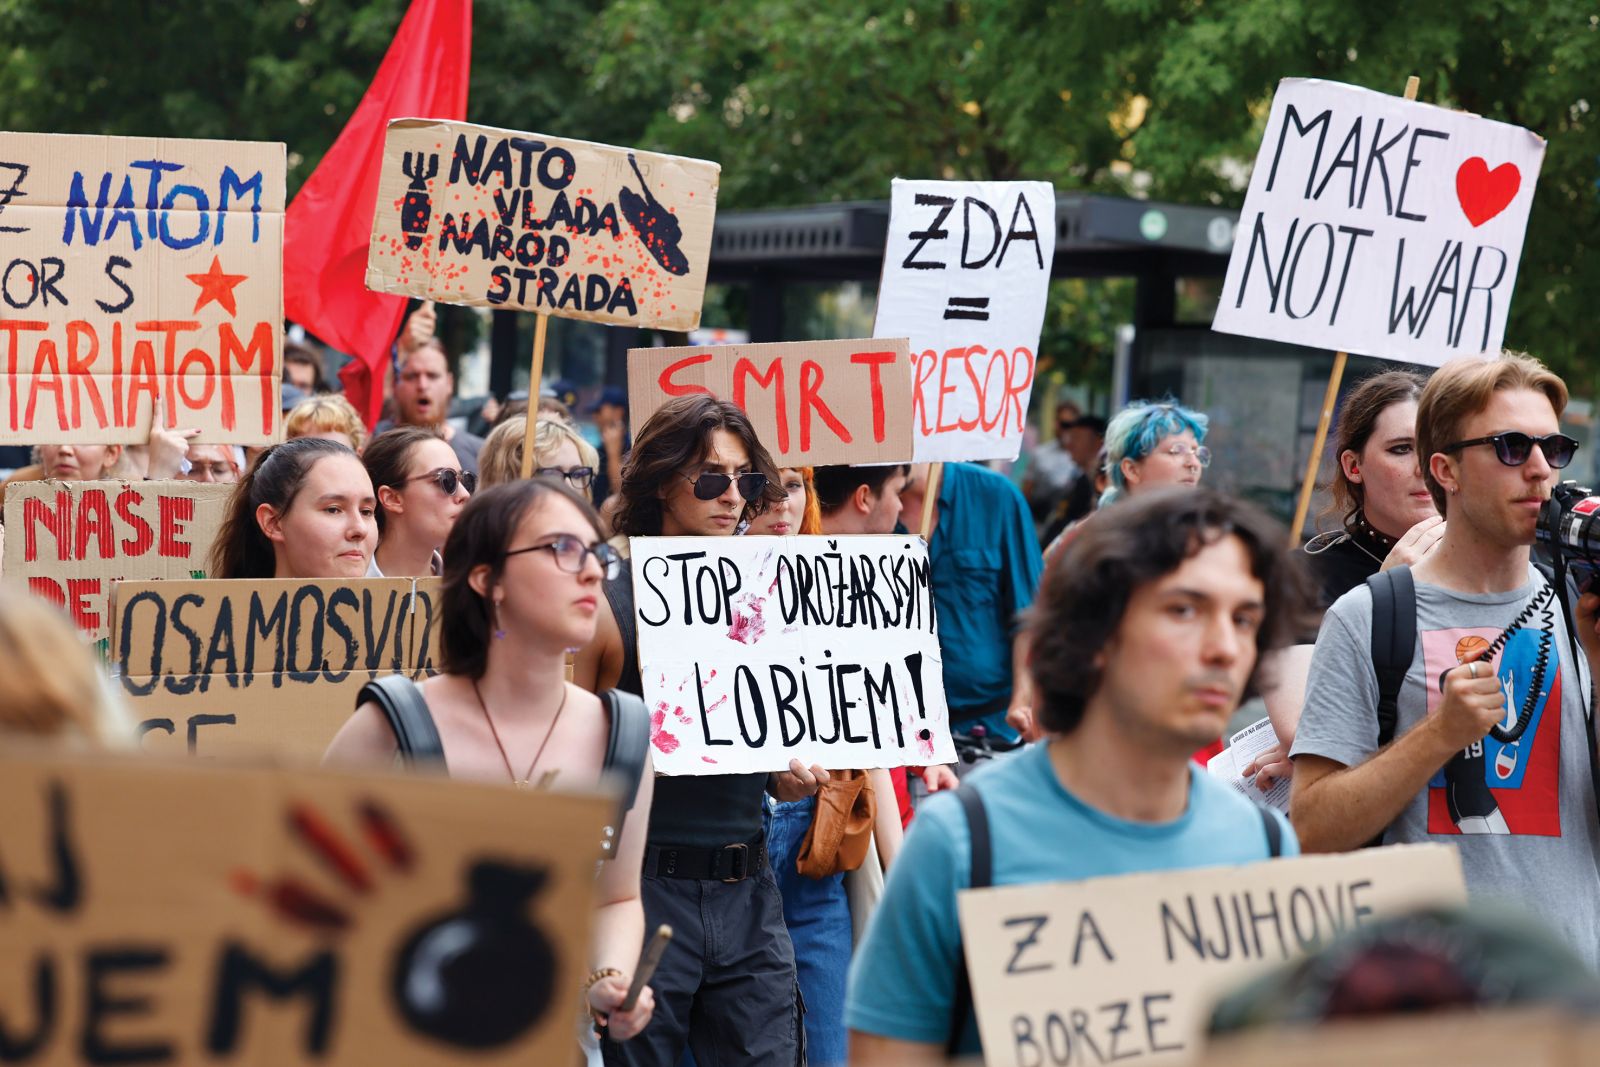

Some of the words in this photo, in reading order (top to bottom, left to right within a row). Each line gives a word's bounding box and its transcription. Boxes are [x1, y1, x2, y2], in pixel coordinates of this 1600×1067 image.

[450, 133, 576, 190] NATO
[1266, 103, 1450, 222] MAKE
[62, 159, 262, 250] NATOM
[439, 212, 570, 268] NAROD
[493, 188, 621, 241] VLADA
[902, 191, 1044, 270] ZDA
[95, 255, 135, 313] S
[486, 265, 638, 316] STRADA
[1235, 212, 1374, 326] NOT
[1388, 237, 1508, 353] WAR
[0, 319, 275, 436] TARIATOM
[658, 351, 897, 454] SMRT
[911, 344, 1035, 438] RESOR
[24, 485, 196, 562] NAŠE
[639, 551, 742, 627] STOP
[776, 540, 935, 635] OROŽARSKIM
[119, 584, 441, 696] OSAMOSVO
[1464, 739, 1483, 760] 19
[1003, 910, 1116, 974] ZA
[1159, 879, 1375, 963] NJIHOVE
[1011, 993, 1186, 1067] BORZE
